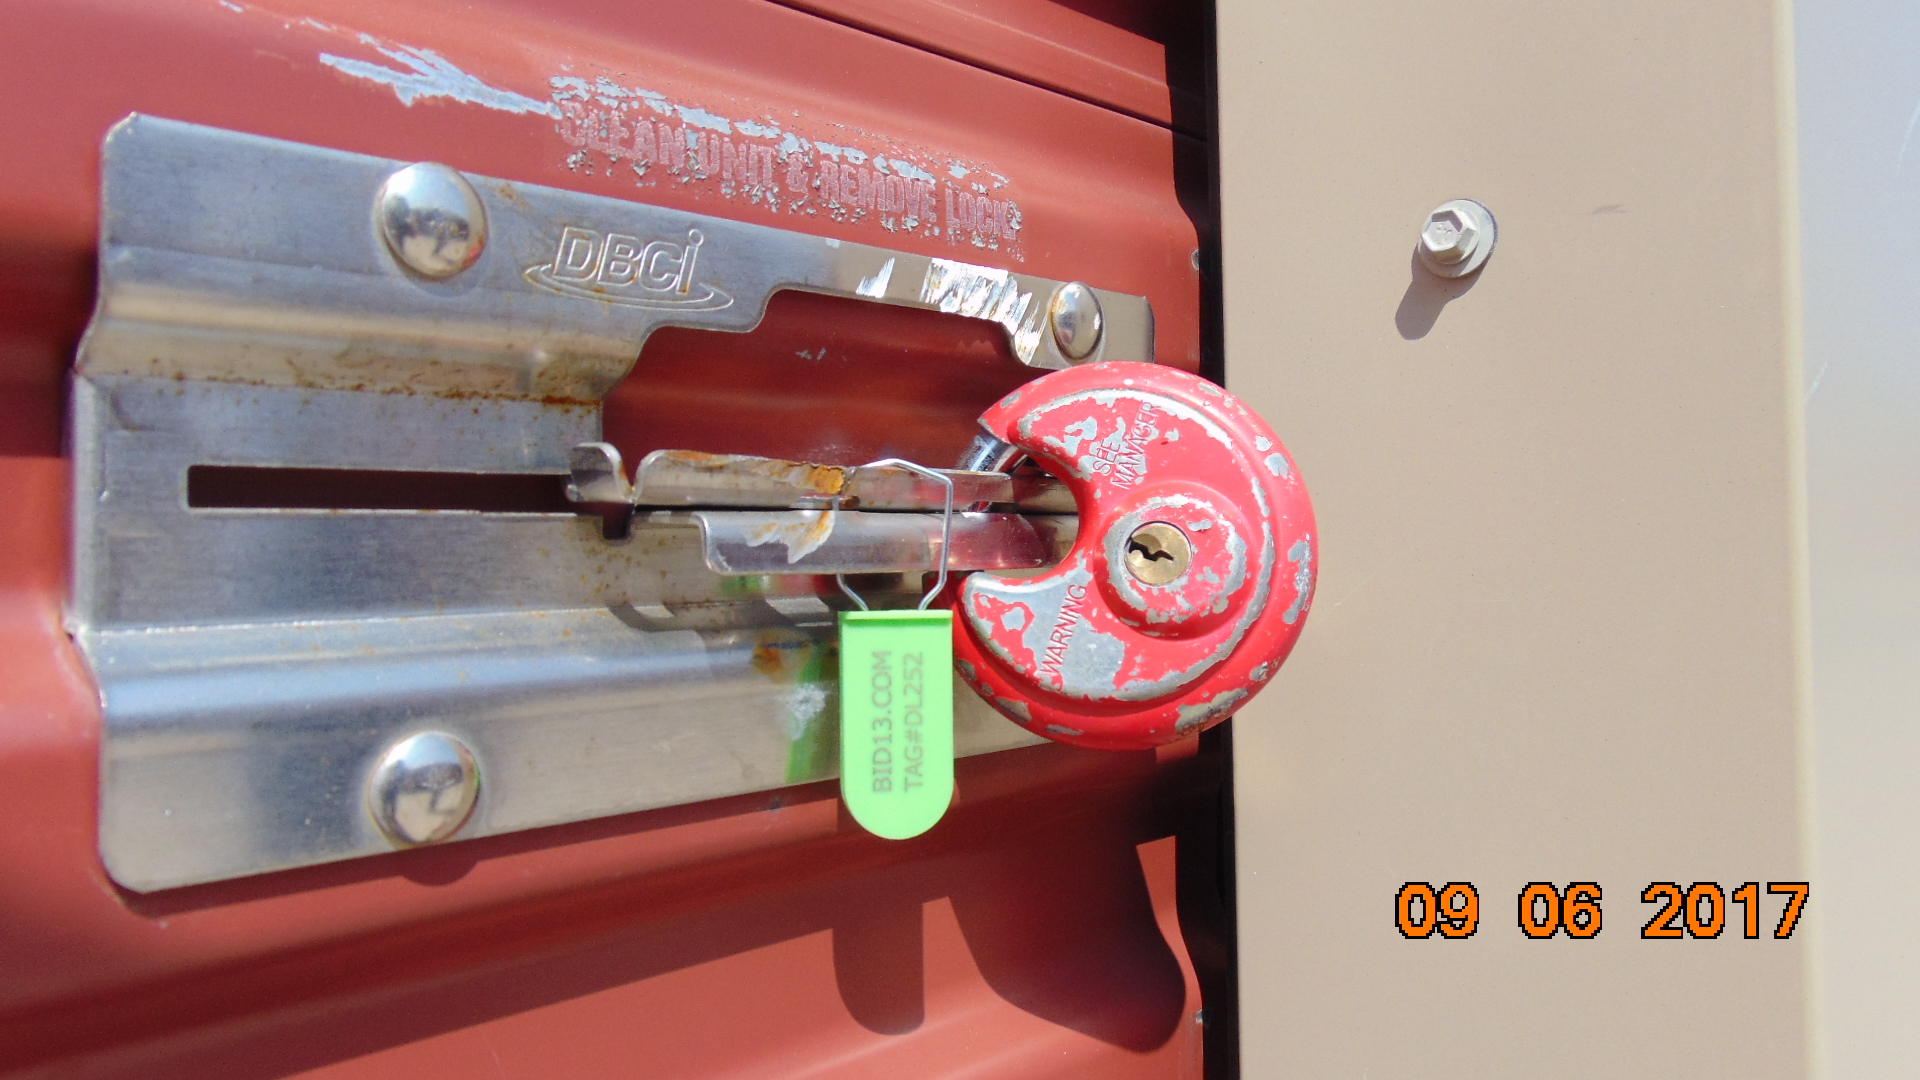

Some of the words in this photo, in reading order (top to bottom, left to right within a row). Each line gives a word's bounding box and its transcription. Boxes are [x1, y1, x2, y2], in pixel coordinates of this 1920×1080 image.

[560, 100, 686, 169] CLEAN
[698, 131, 775, 187] UNIT
[820, 160, 938, 223] REMOVE
[1092, 438, 1121, 475] SEE
[1110, 401, 1161, 490] MANAGER
[1040, 584, 1087, 676] WARNING
[872, 650, 893, 793] BID13.COM
[903, 652, 924, 793] TAG#DL252
